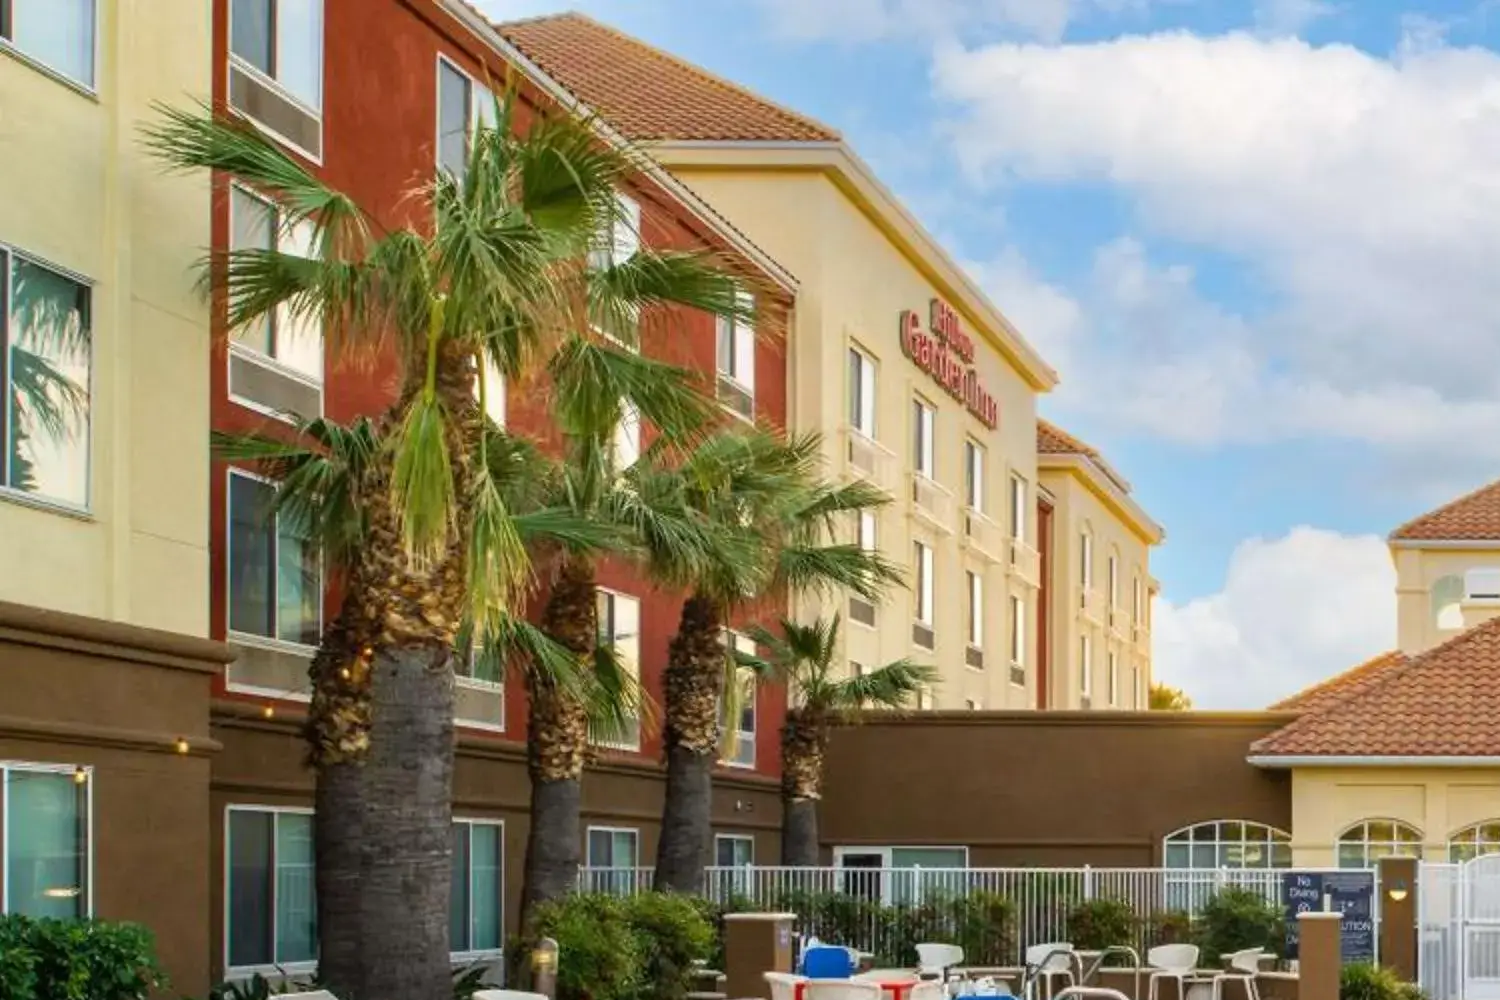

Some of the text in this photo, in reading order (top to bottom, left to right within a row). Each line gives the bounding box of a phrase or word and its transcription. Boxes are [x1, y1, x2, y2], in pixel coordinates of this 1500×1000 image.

[900, 309, 966, 405] Garden
[1297, 876, 1311, 886] No
[1289, 887, 1318, 899] Diving
[1341, 921, 1371, 931] UTION
